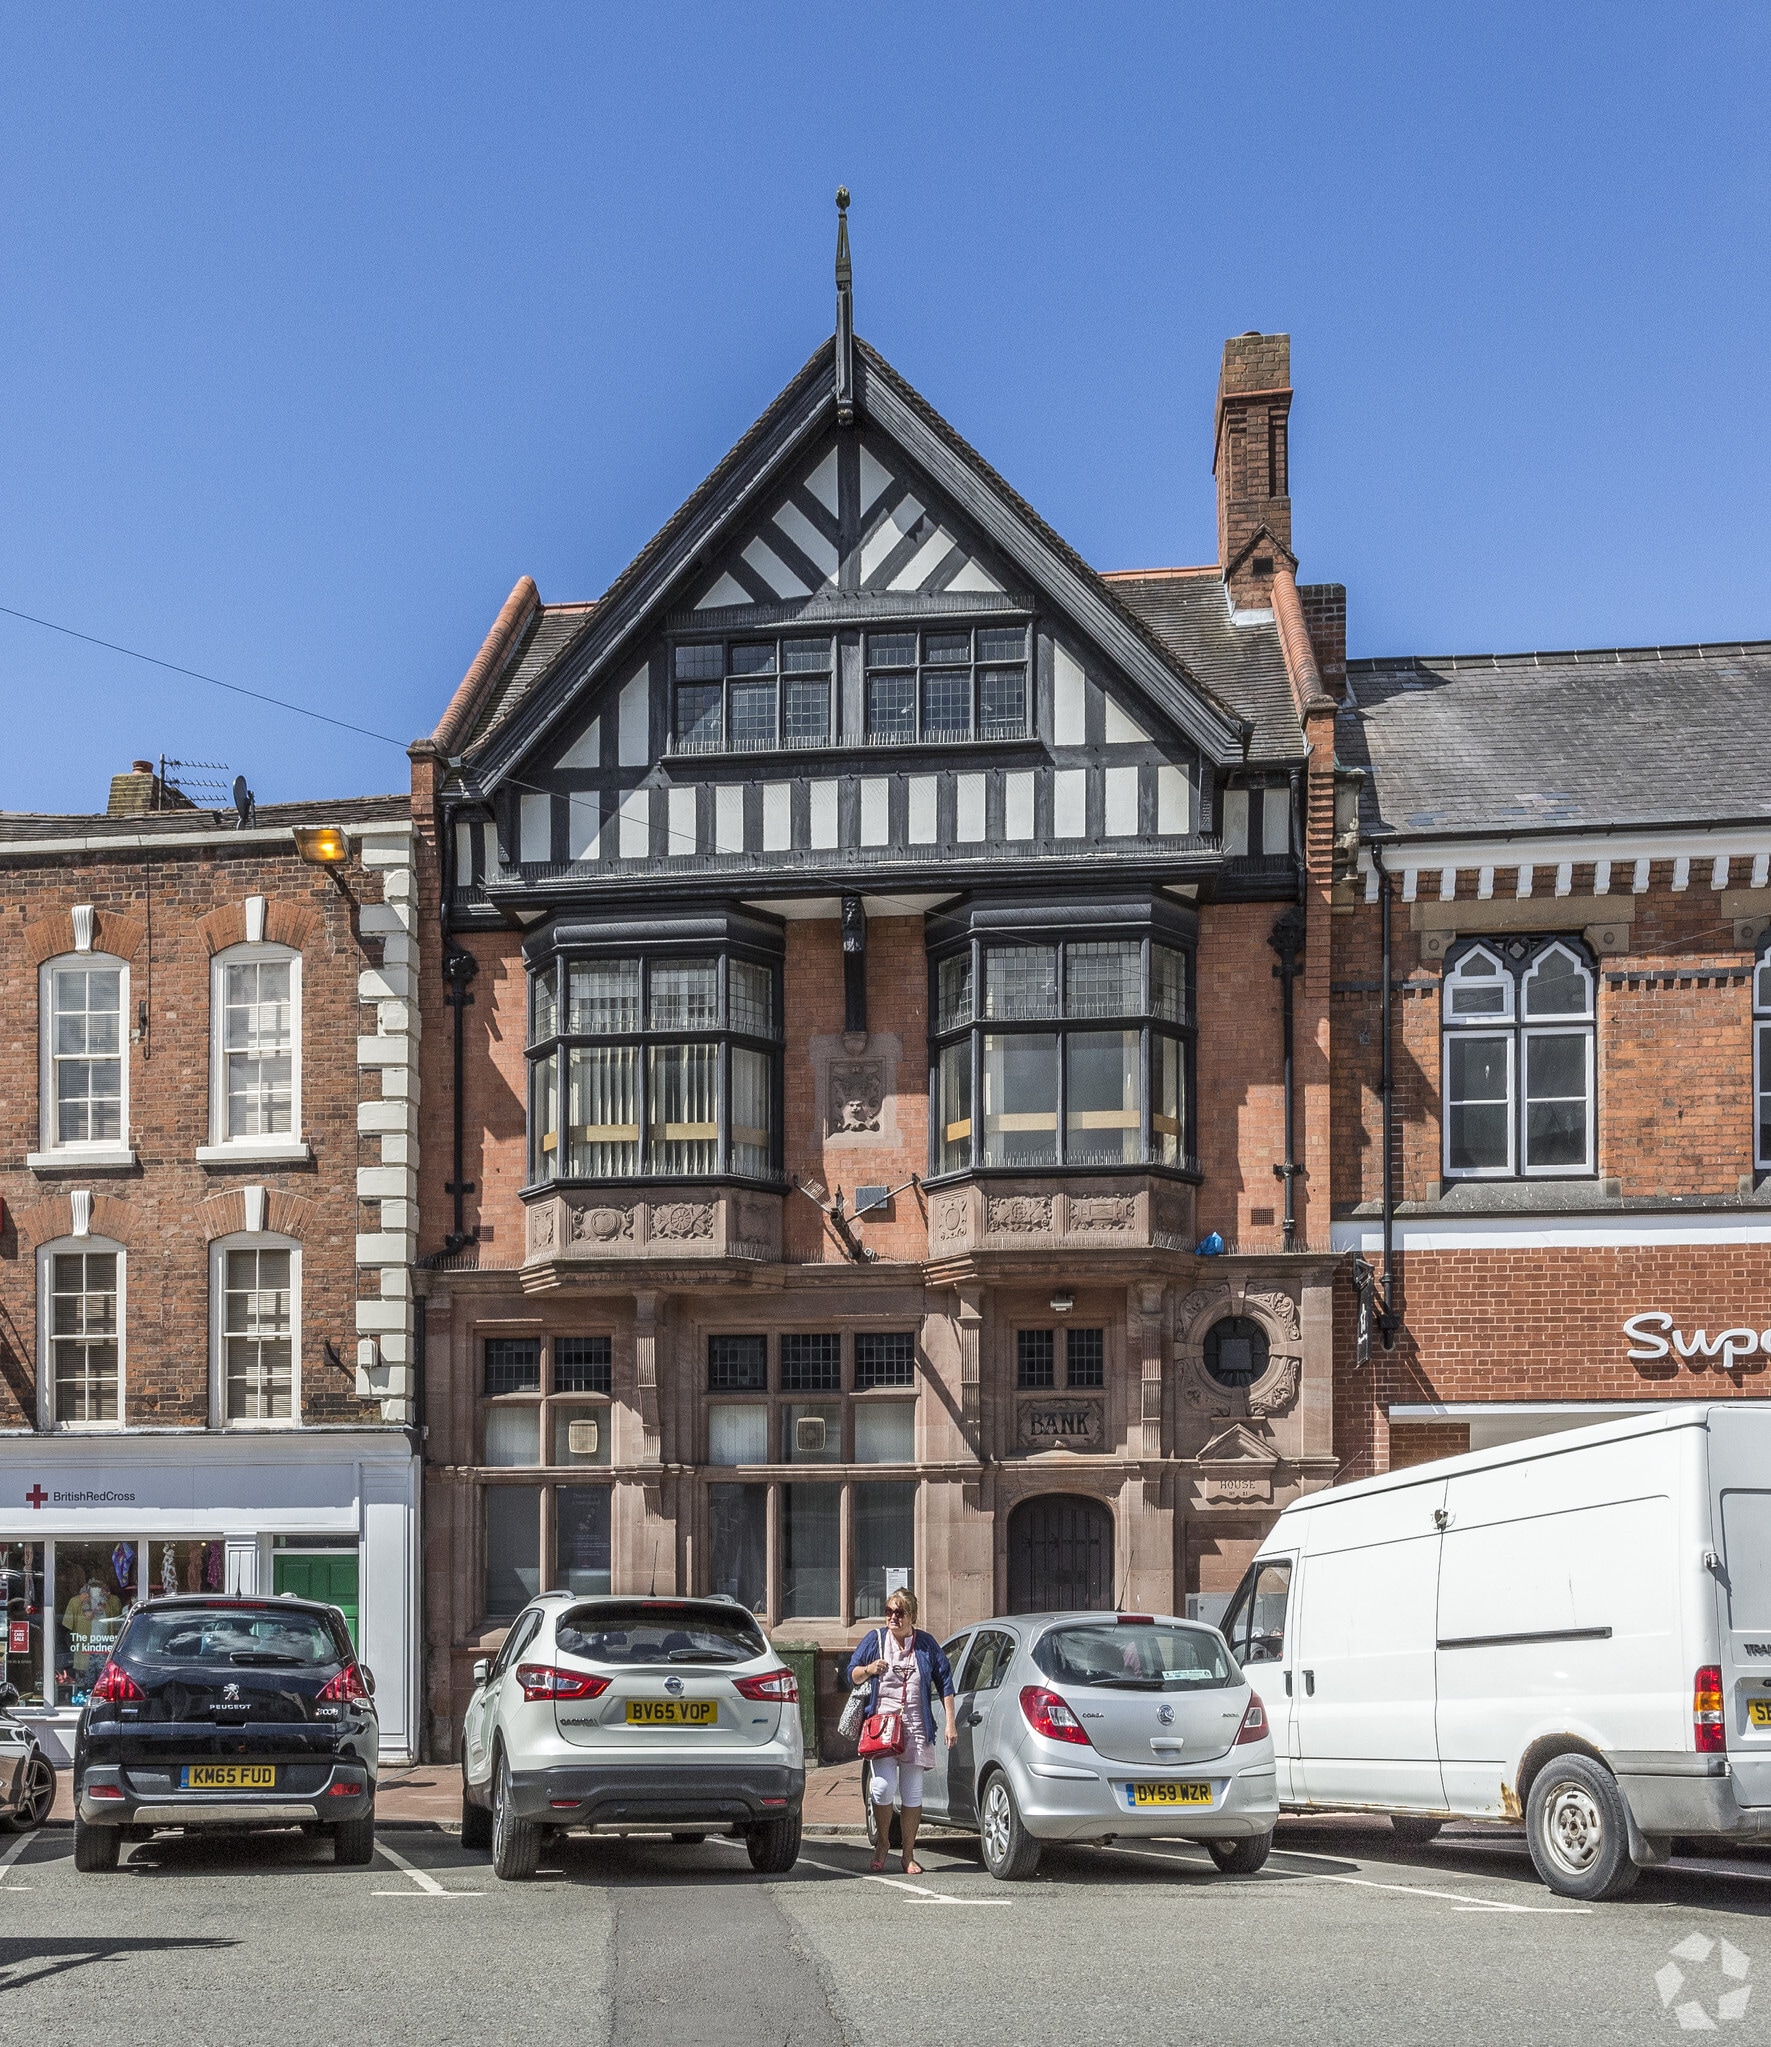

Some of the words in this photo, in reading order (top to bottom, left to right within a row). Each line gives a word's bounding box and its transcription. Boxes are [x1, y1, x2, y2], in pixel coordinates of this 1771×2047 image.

[1030, 1411, 1090, 1436] BANK
[1220, 1480, 1256, 1489] HOUSE
[53, 1491, 136, 1501] BritishRedCross
[70, 1632, 88, 1642] The
[70, 1642, 80, 1652] of
[633, 1703, 675, 1720] BV65
[682, 1703, 710, 1719] VOP
[193, 1768, 236, 1784] KM65
[240, 1767, 272, 1784] FUD
[1137, 1784, 1177, 1801] DY59
[1180, 1784, 1210, 1801] WZR
